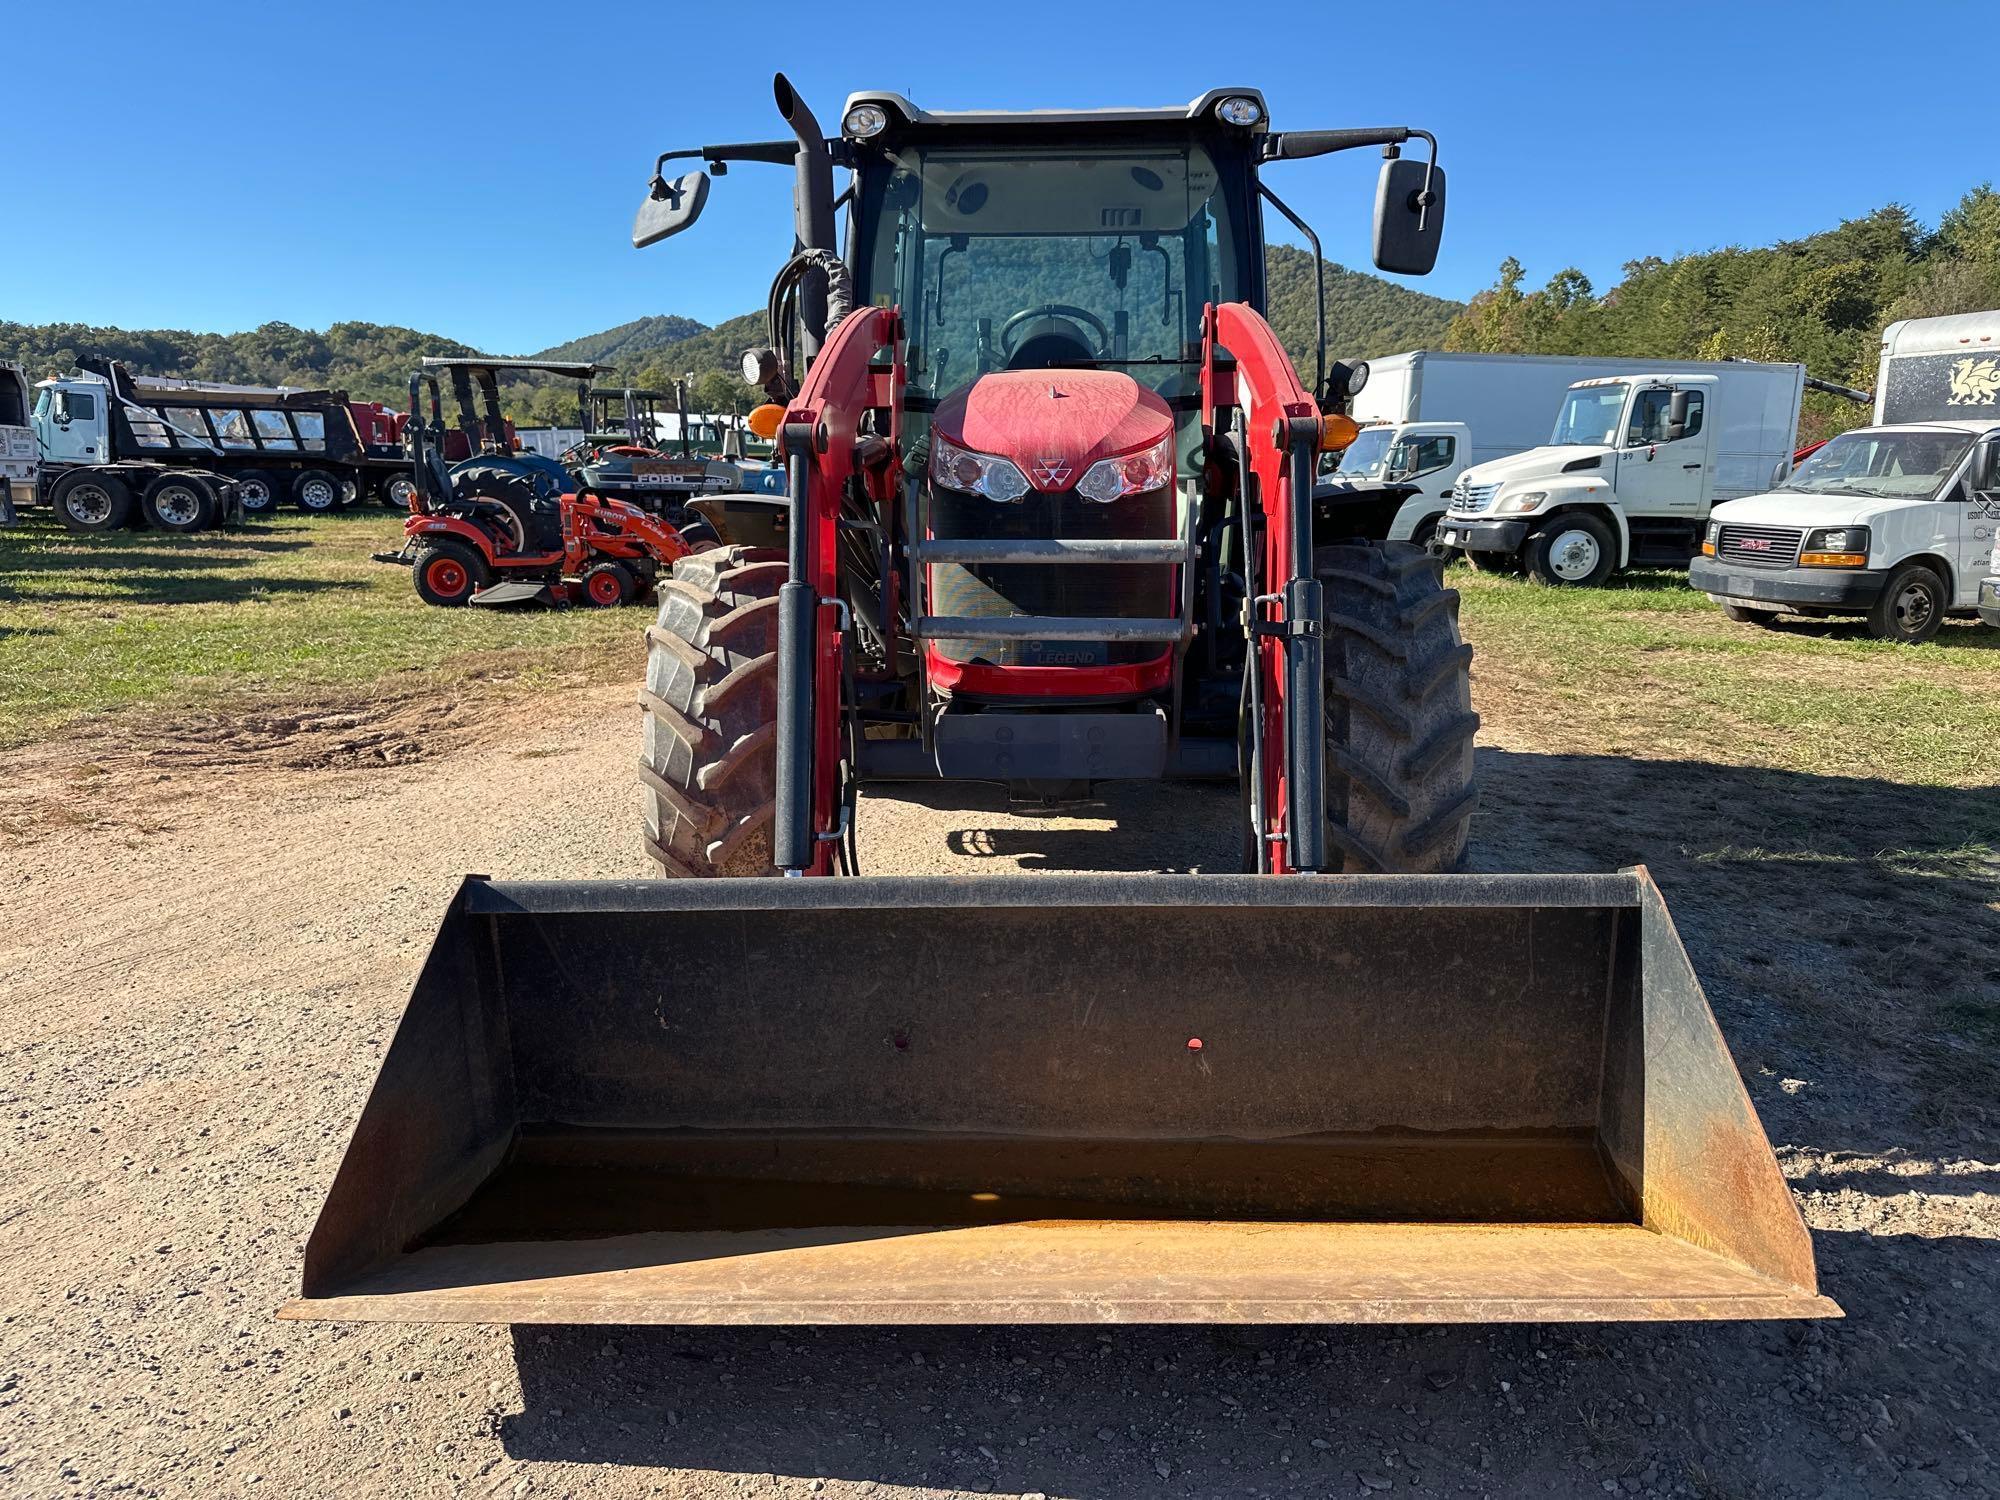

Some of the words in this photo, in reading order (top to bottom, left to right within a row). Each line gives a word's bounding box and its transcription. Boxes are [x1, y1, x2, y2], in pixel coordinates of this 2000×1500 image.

[1622, 452, 1634, 460] 39
[637, 474, 684, 483] FORD
[594, 508, 628, 522] KUBOTA
[1738, 538, 1771, 550] GMC
[1037, 651, 1095, 664] LEGEND
